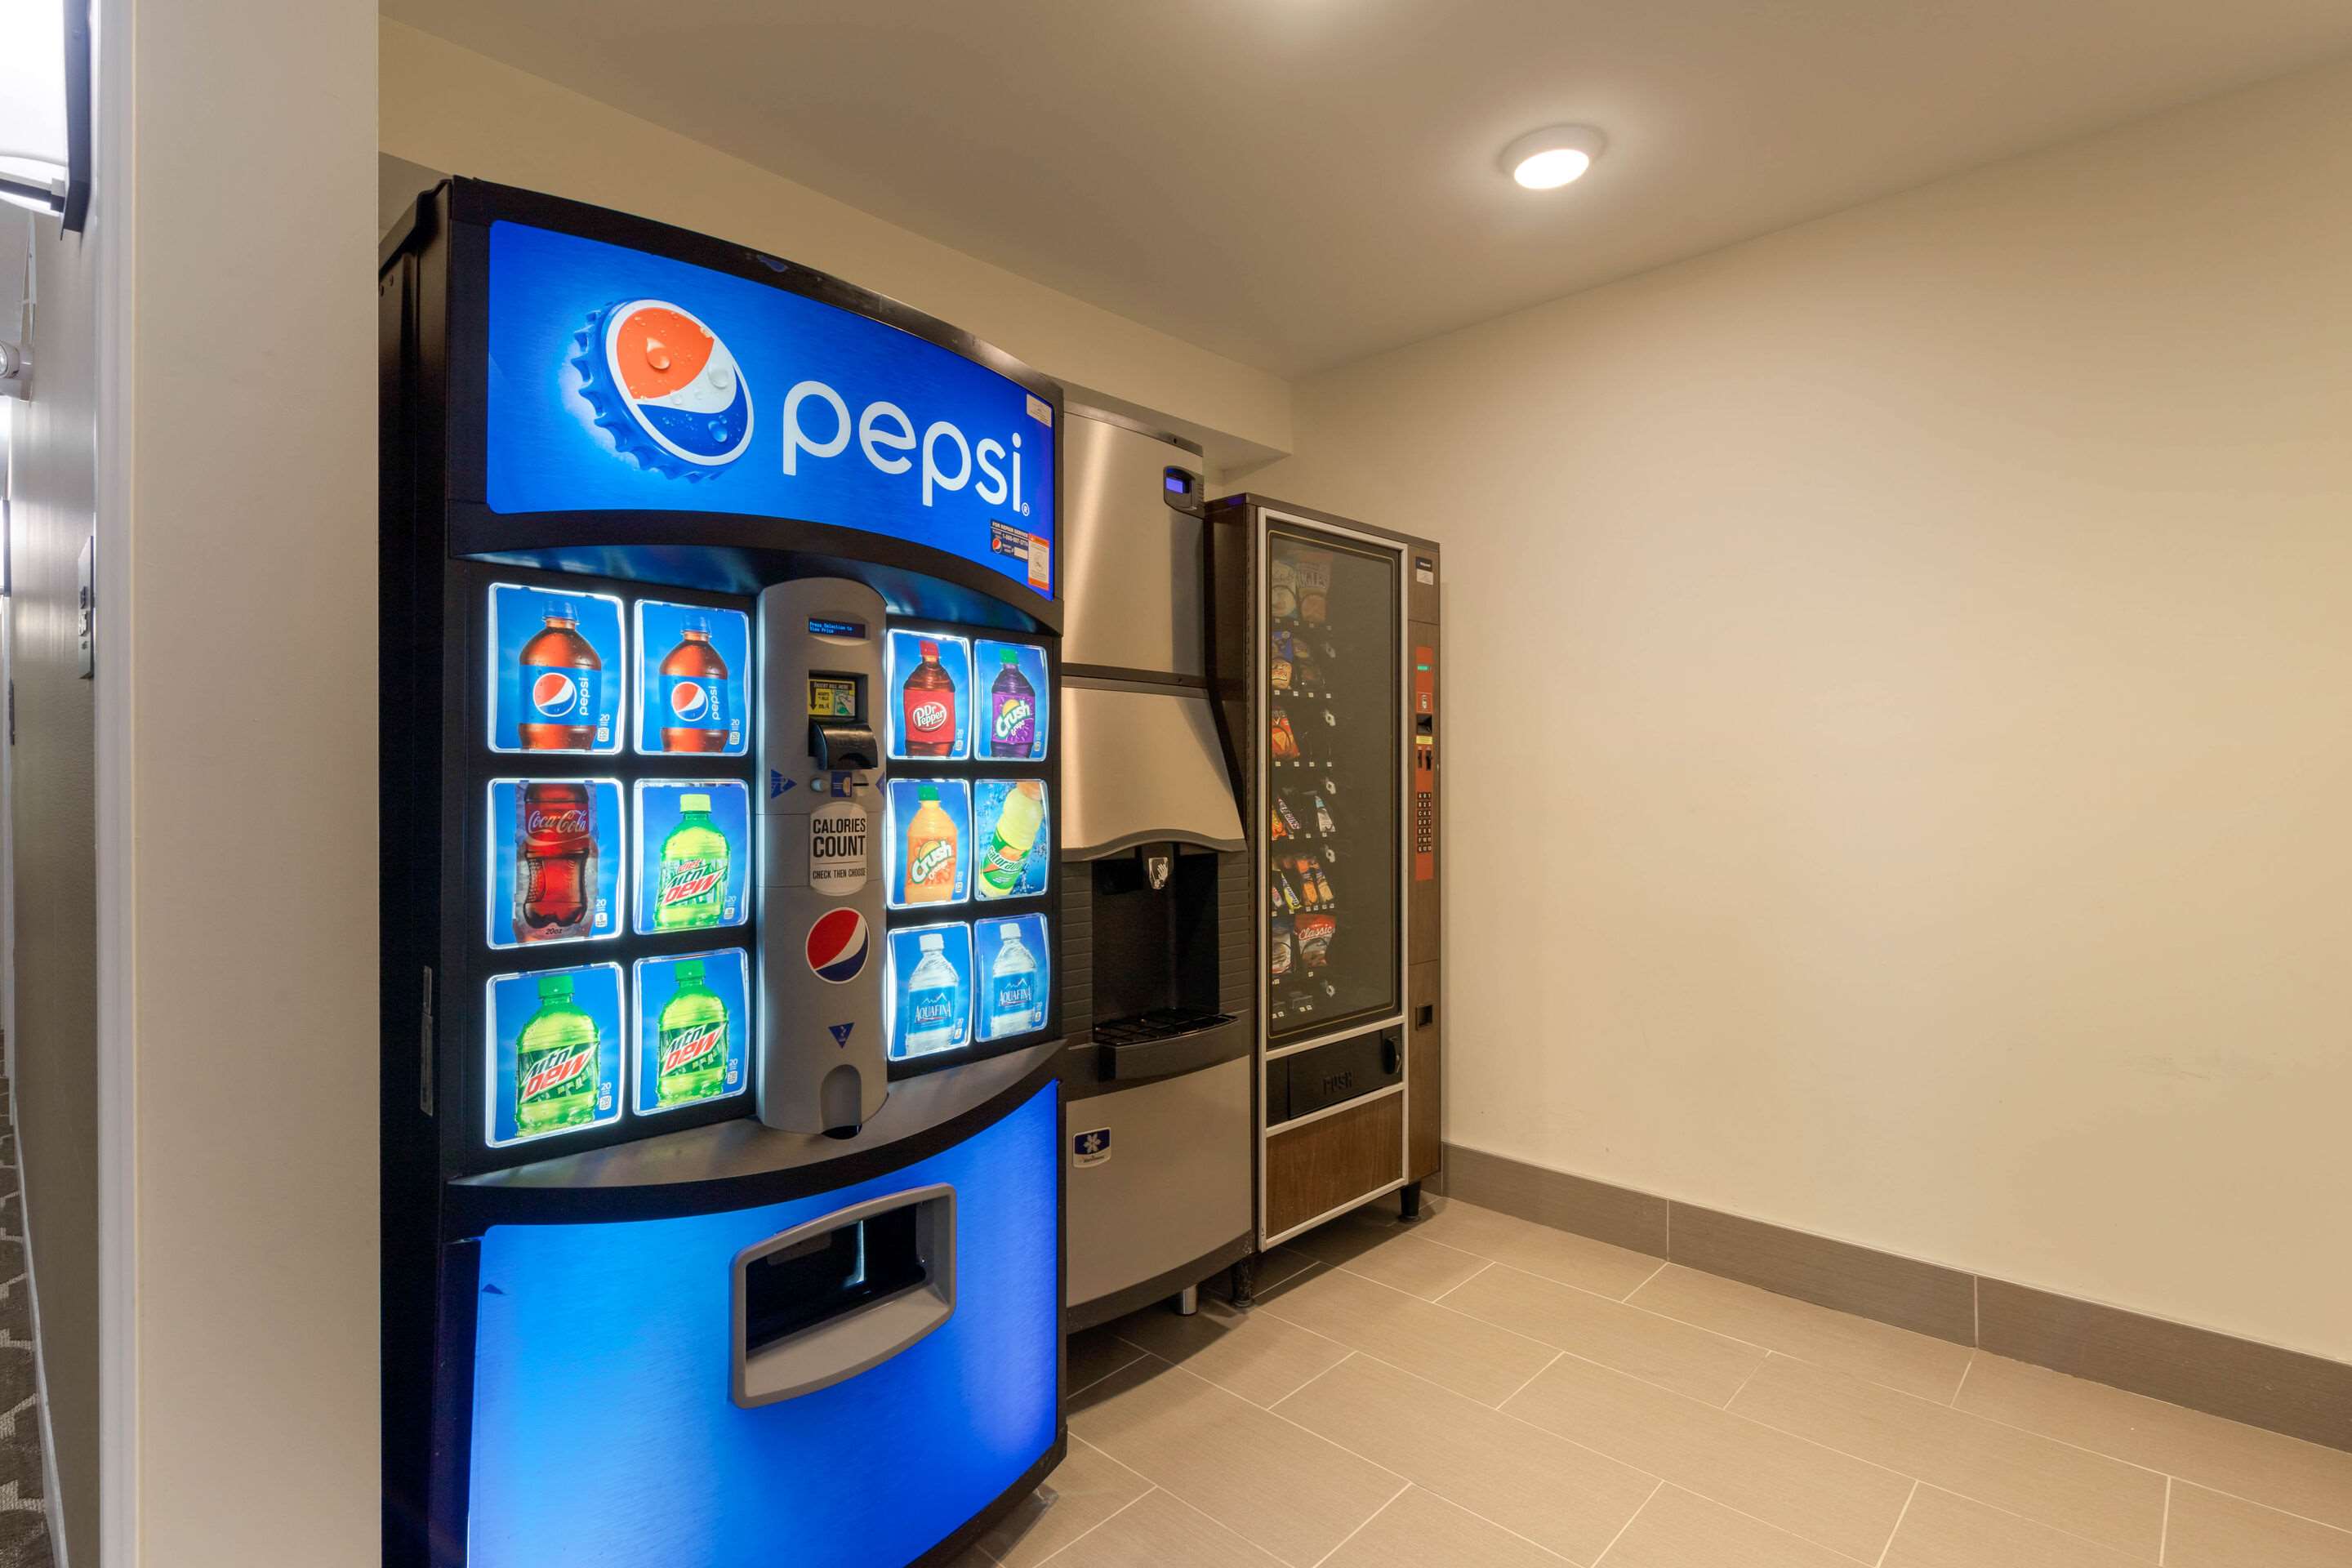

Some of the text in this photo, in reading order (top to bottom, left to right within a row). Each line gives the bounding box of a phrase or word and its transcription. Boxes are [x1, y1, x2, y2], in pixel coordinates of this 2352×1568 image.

[782, 380, 1022, 513] pepsi
[578, 676, 589, 716] pepsi
[708, 685, 720, 720] pepsi
[916, 707, 944, 727] Pepper
[924, 705, 937, 716] Dr
[996, 700, 1031, 737] Crush
[528, 809, 587, 834] Coca-Cola
[813, 818, 866, 834] CALORIES
[813, 835, 866, 858] COUNT
[911, 840, 952, 883] Crush
[813, 868, 866, 880] CHECK THEN CHOOSE
[1298, 925, 1333, 941] Classic
[999, 986, 1031, 1007] AQUAFINA
[915, 1001, 951, 1022] AQUAFINA
